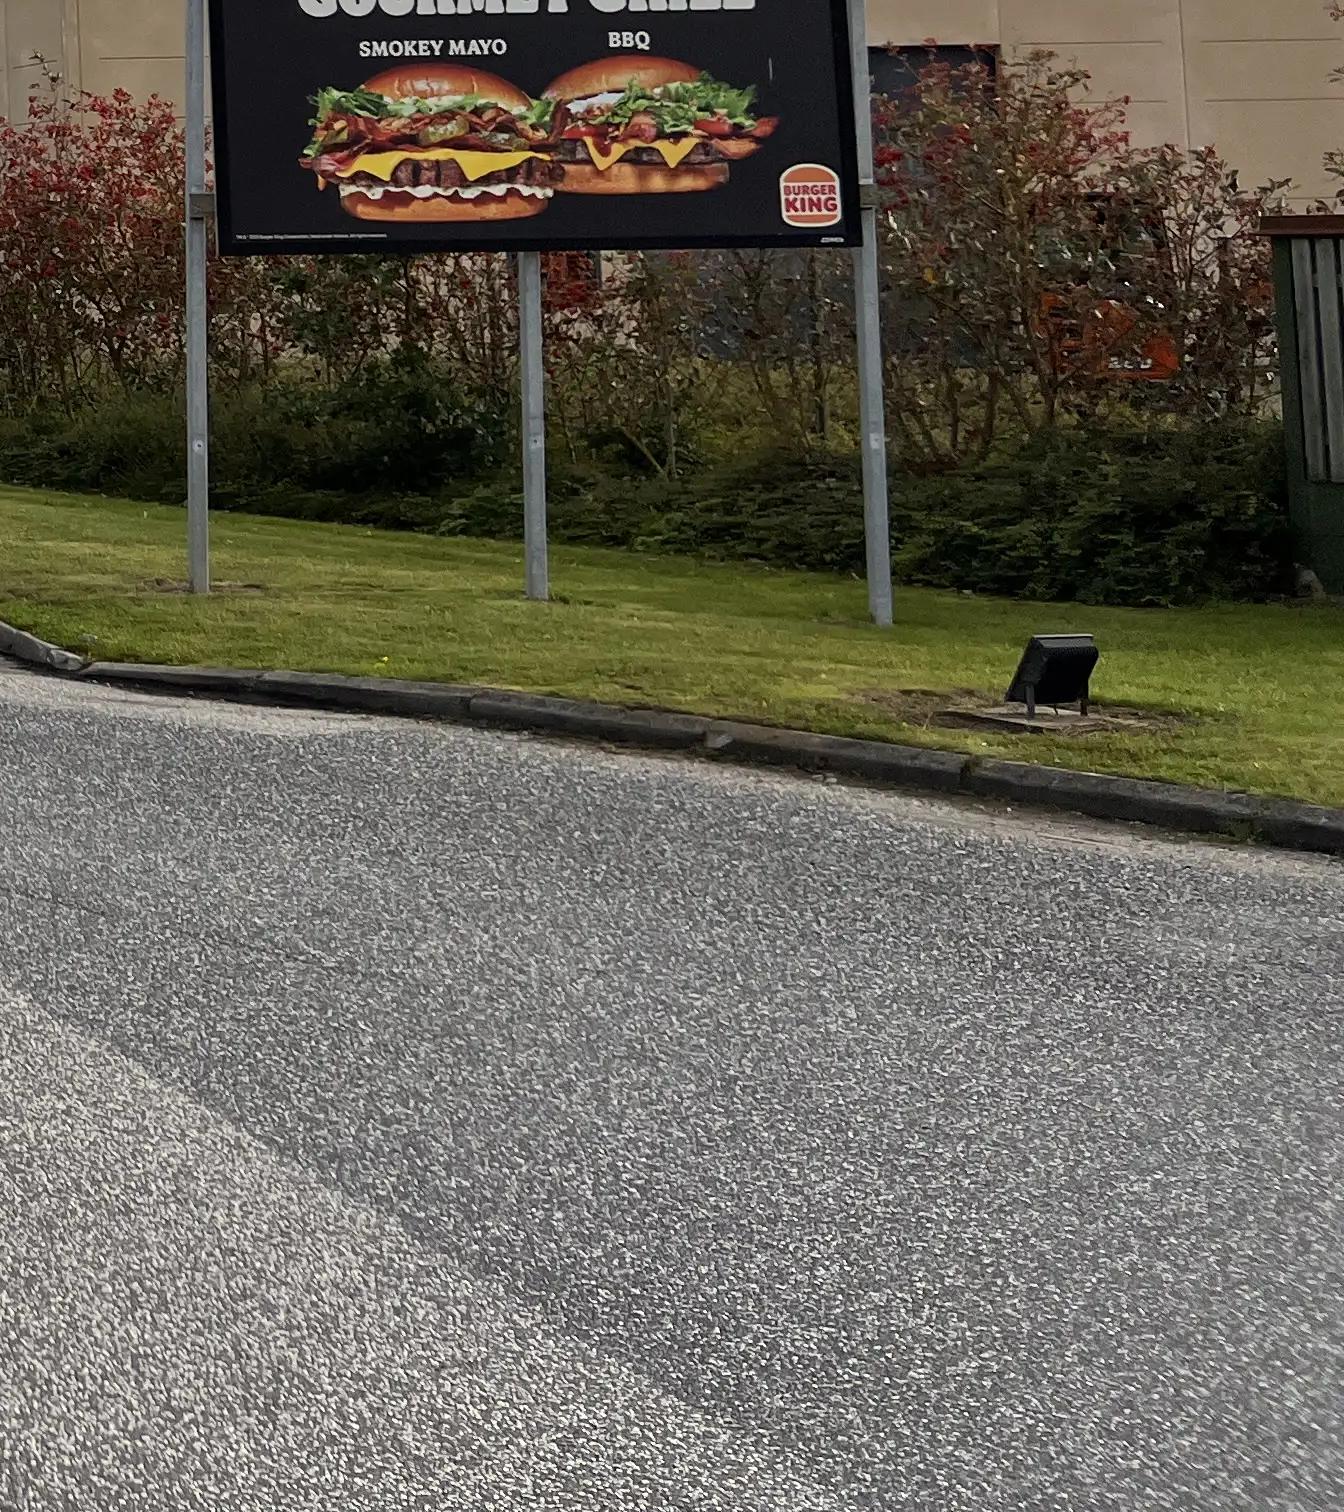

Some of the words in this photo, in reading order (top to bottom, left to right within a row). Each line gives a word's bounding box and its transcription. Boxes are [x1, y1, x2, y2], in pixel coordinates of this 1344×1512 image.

[359, 39, 445, 58] SMOKEY
[448, 38, 508, 56] MAYO
[608, 31, 651, 51] BBQ
[784, 184, 837, 196] BURGER
[784, 197, 838, 213] KING
